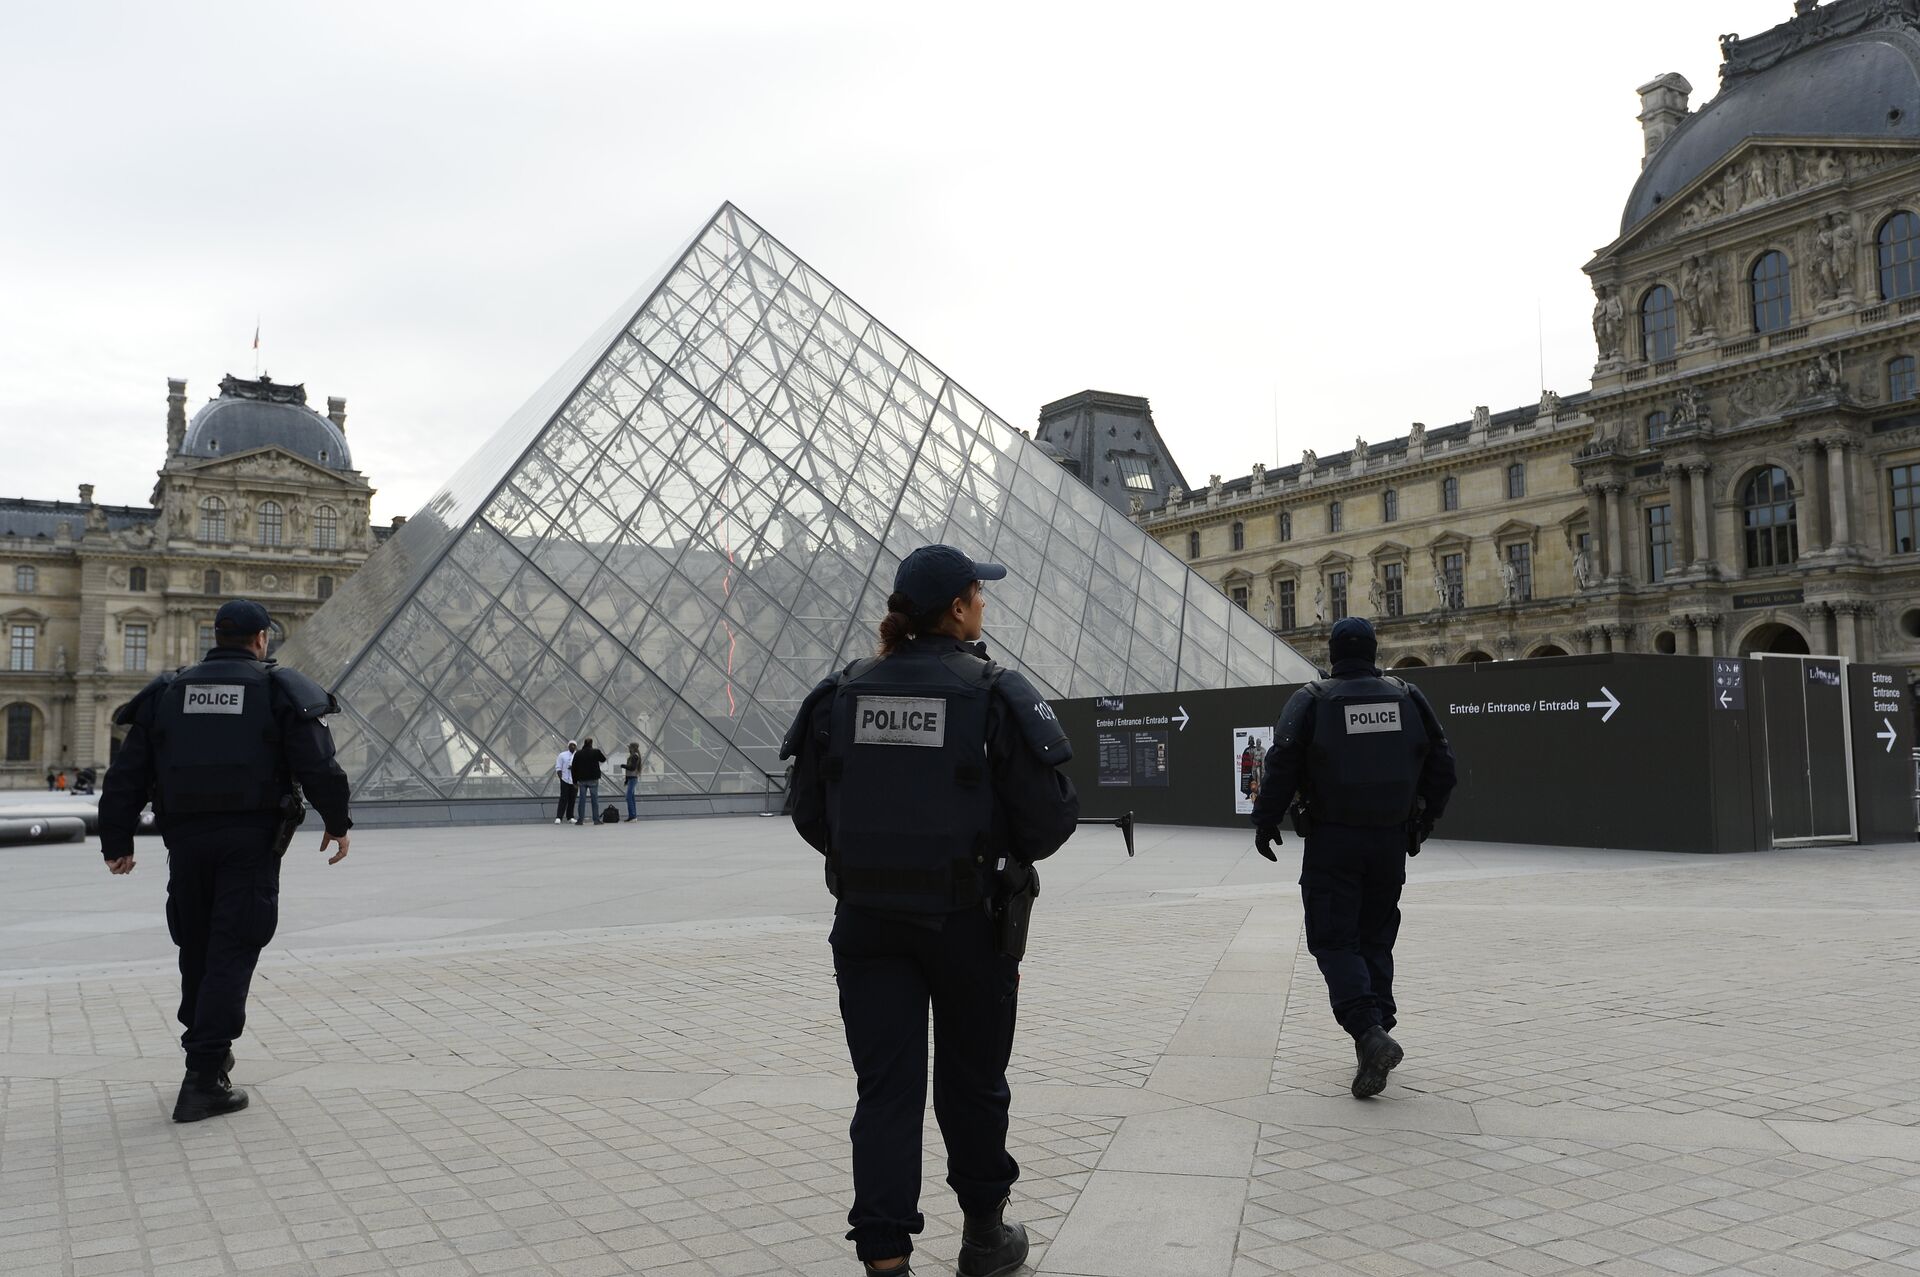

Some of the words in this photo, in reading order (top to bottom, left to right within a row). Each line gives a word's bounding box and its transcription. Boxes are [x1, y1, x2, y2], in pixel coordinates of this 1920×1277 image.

[1873, 686, 1900, 698] Entrance
[188, 693, 239, 706] POLICE
[1450, 702, 1480, 714] Entrée
[1487, 702, 1531, 713] Entrance
[1539, 699, 1580, 711] Entrada
[1874, 701, 1899, 712] Entrada
[862, 709, 938, 732] POLICE
[1117, 717, 1142, 726] Entrance
[1145, 715, 1169, 725] Entrada
[1350, 711, 1397, 725] POLICE
